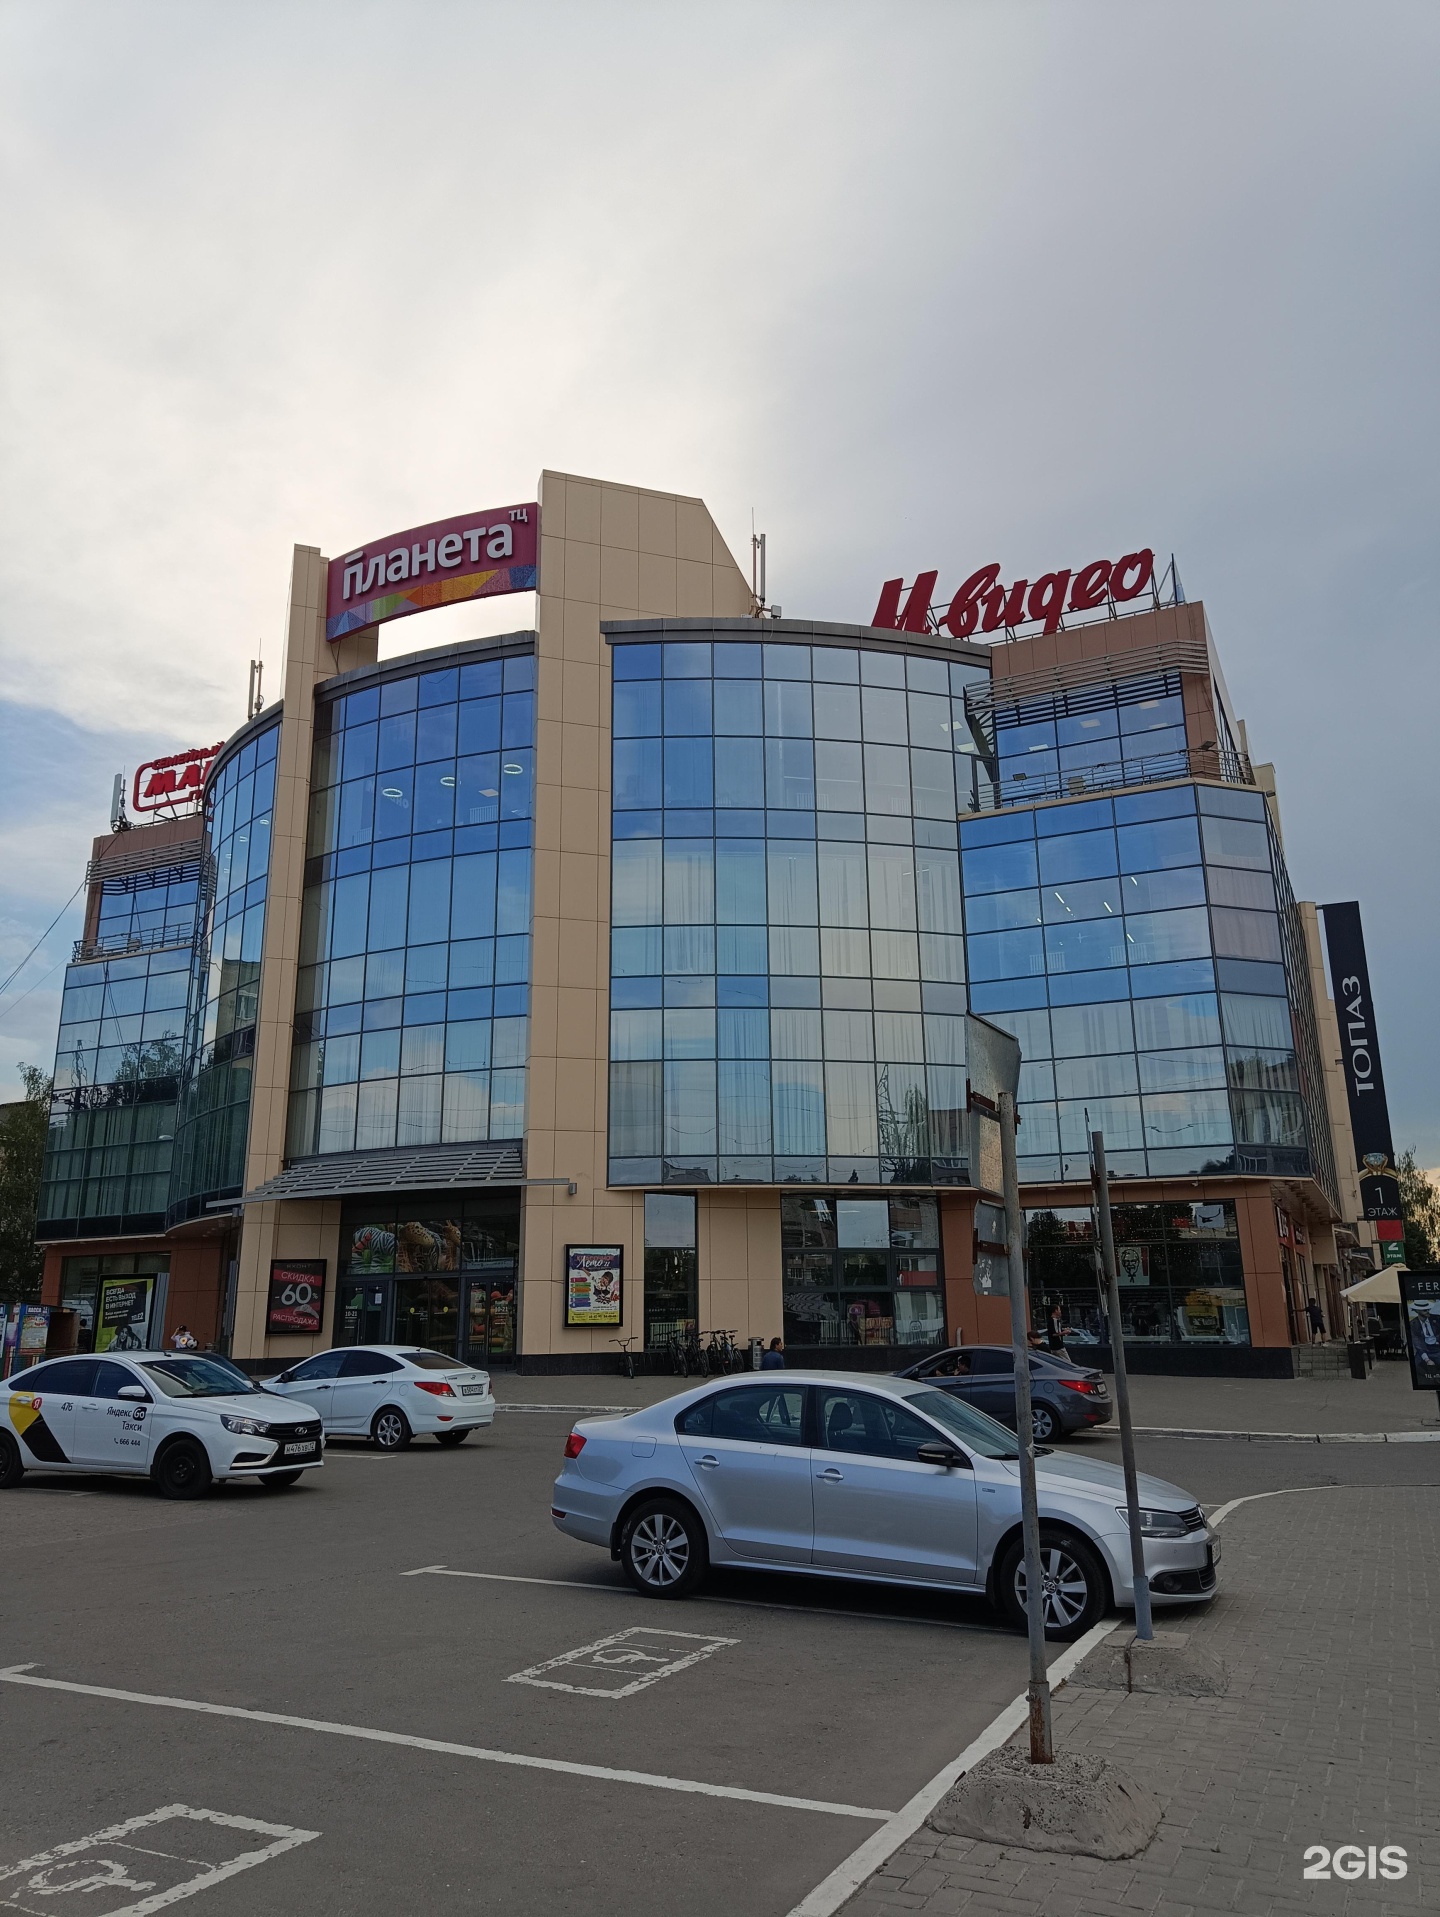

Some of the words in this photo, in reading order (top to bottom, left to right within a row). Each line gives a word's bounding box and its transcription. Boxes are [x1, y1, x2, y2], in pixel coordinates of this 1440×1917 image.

[508, 507, 529, 523] ТЦ
[1342, 975, 1375, 1097] ТОПАЗ
[1375, 1187, 1384, 1204] 1
[1367, 1207, 1398, 1217] ЭТАЖ
[281, 1271, 315, 1284] СКИДКА
[118, 1292, 137, 1300] ВЫХОД
[110, 1300, 134, 1309] ИНТЕРНЕТ
[272, 1313, 318, 1326] РАСПРОДАЖА
[61, 1402, 73, 1412] 476
[106, 1406, 133, 1418] Яндекс
[133, 1408, 146, 1419] Go
[121, 1421, 143, 1432] Такси
[119, 1438, 130, 1446] 666
